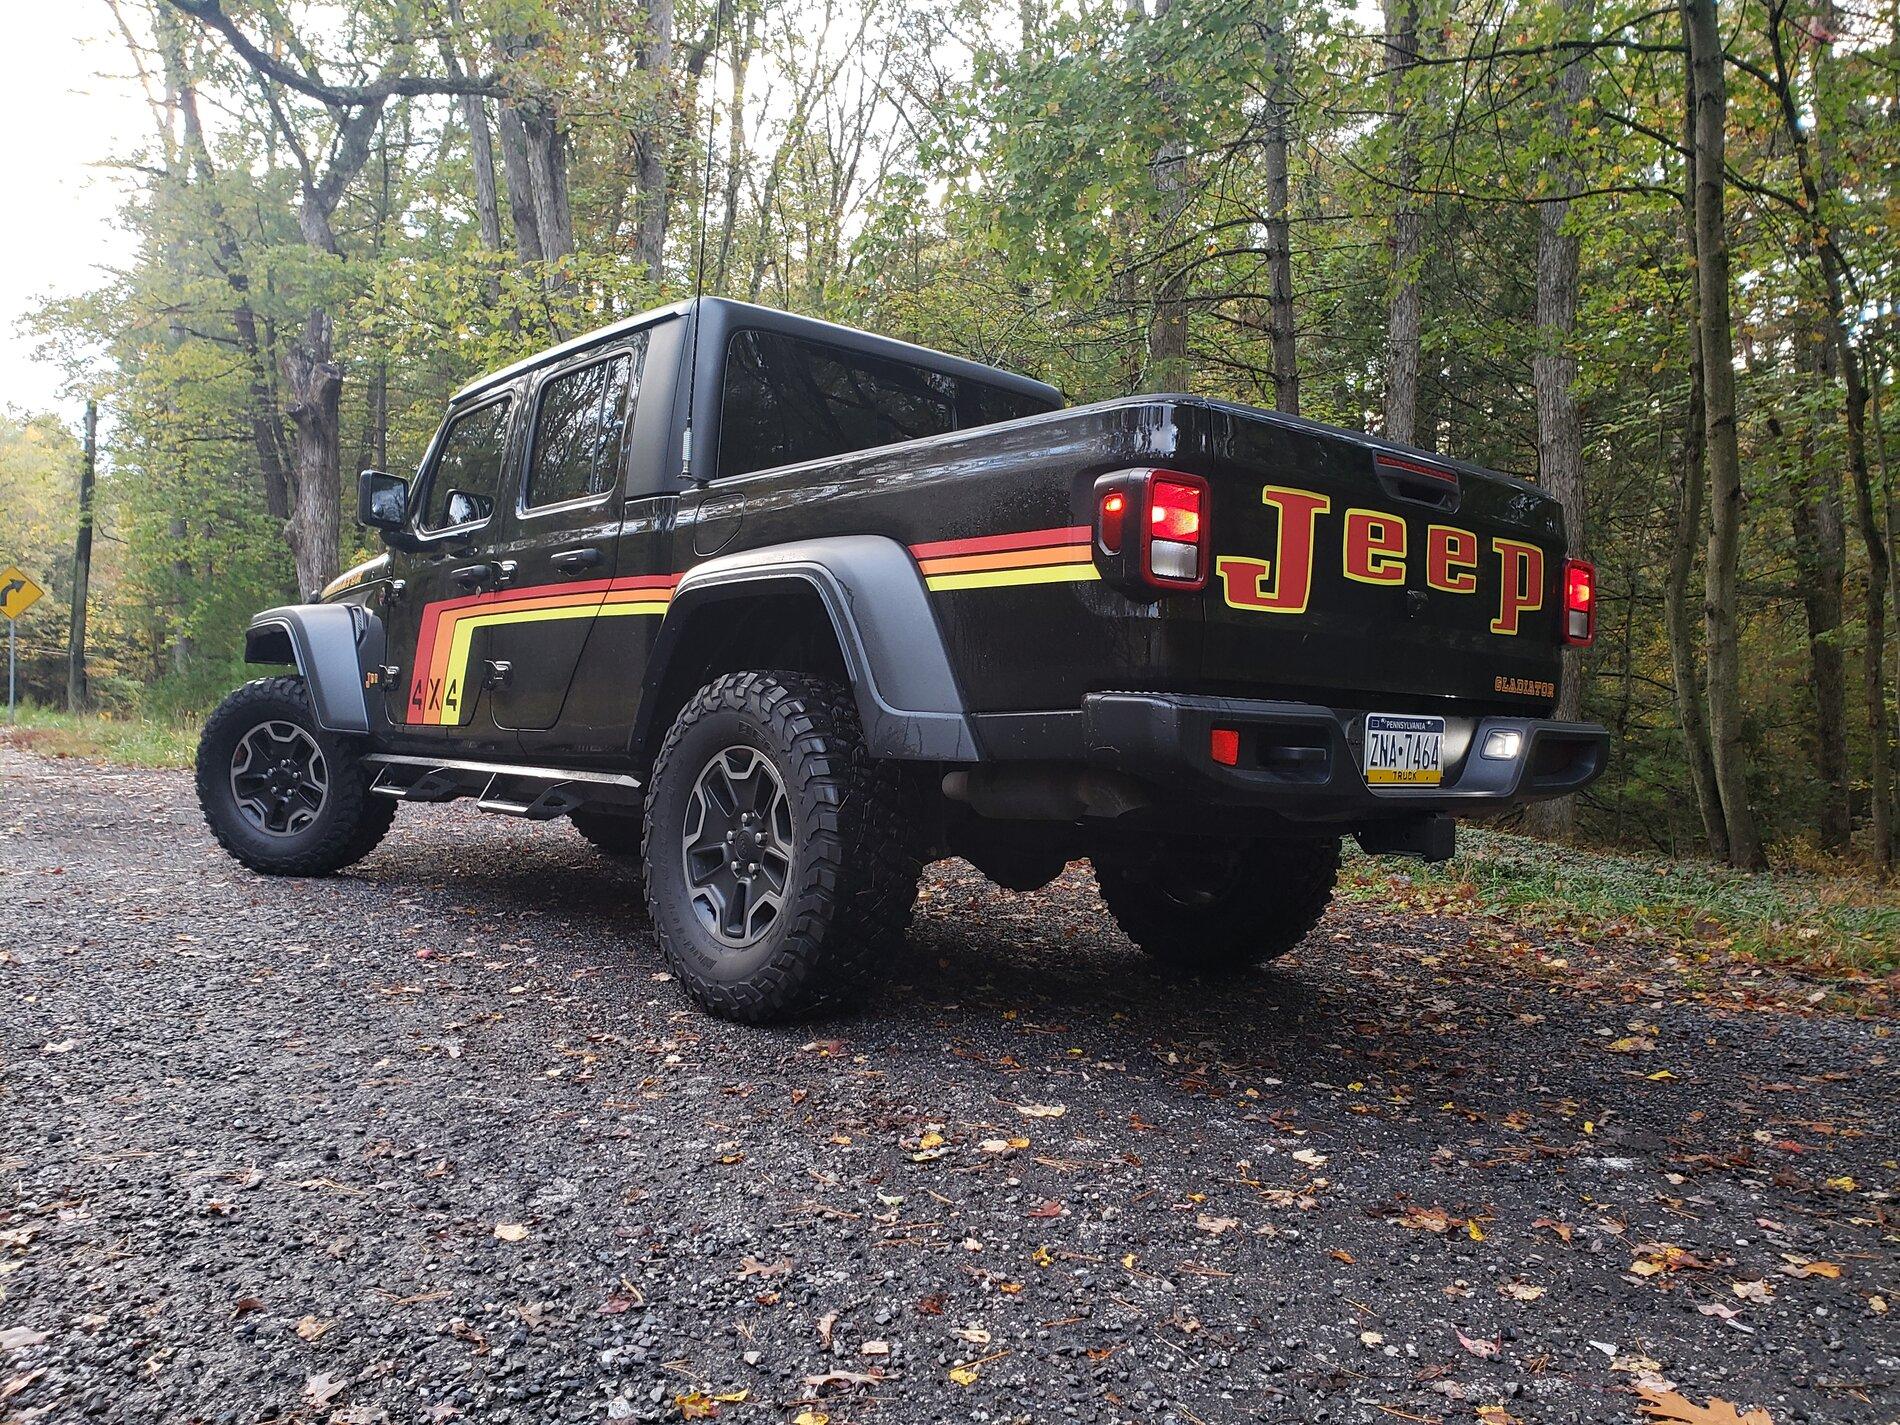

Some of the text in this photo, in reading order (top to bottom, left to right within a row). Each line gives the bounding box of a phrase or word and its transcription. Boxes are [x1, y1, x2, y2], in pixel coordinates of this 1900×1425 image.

[1216, 484, 1544, 635] Jeep
[412, 678, 457, 711] 4X4
[1494, 676, 1555, 698] GLADIATOR
[1386, 720, 1426, 730] PENNSYLVANIA
[1392, 771, 1417, 781] TRUCK
